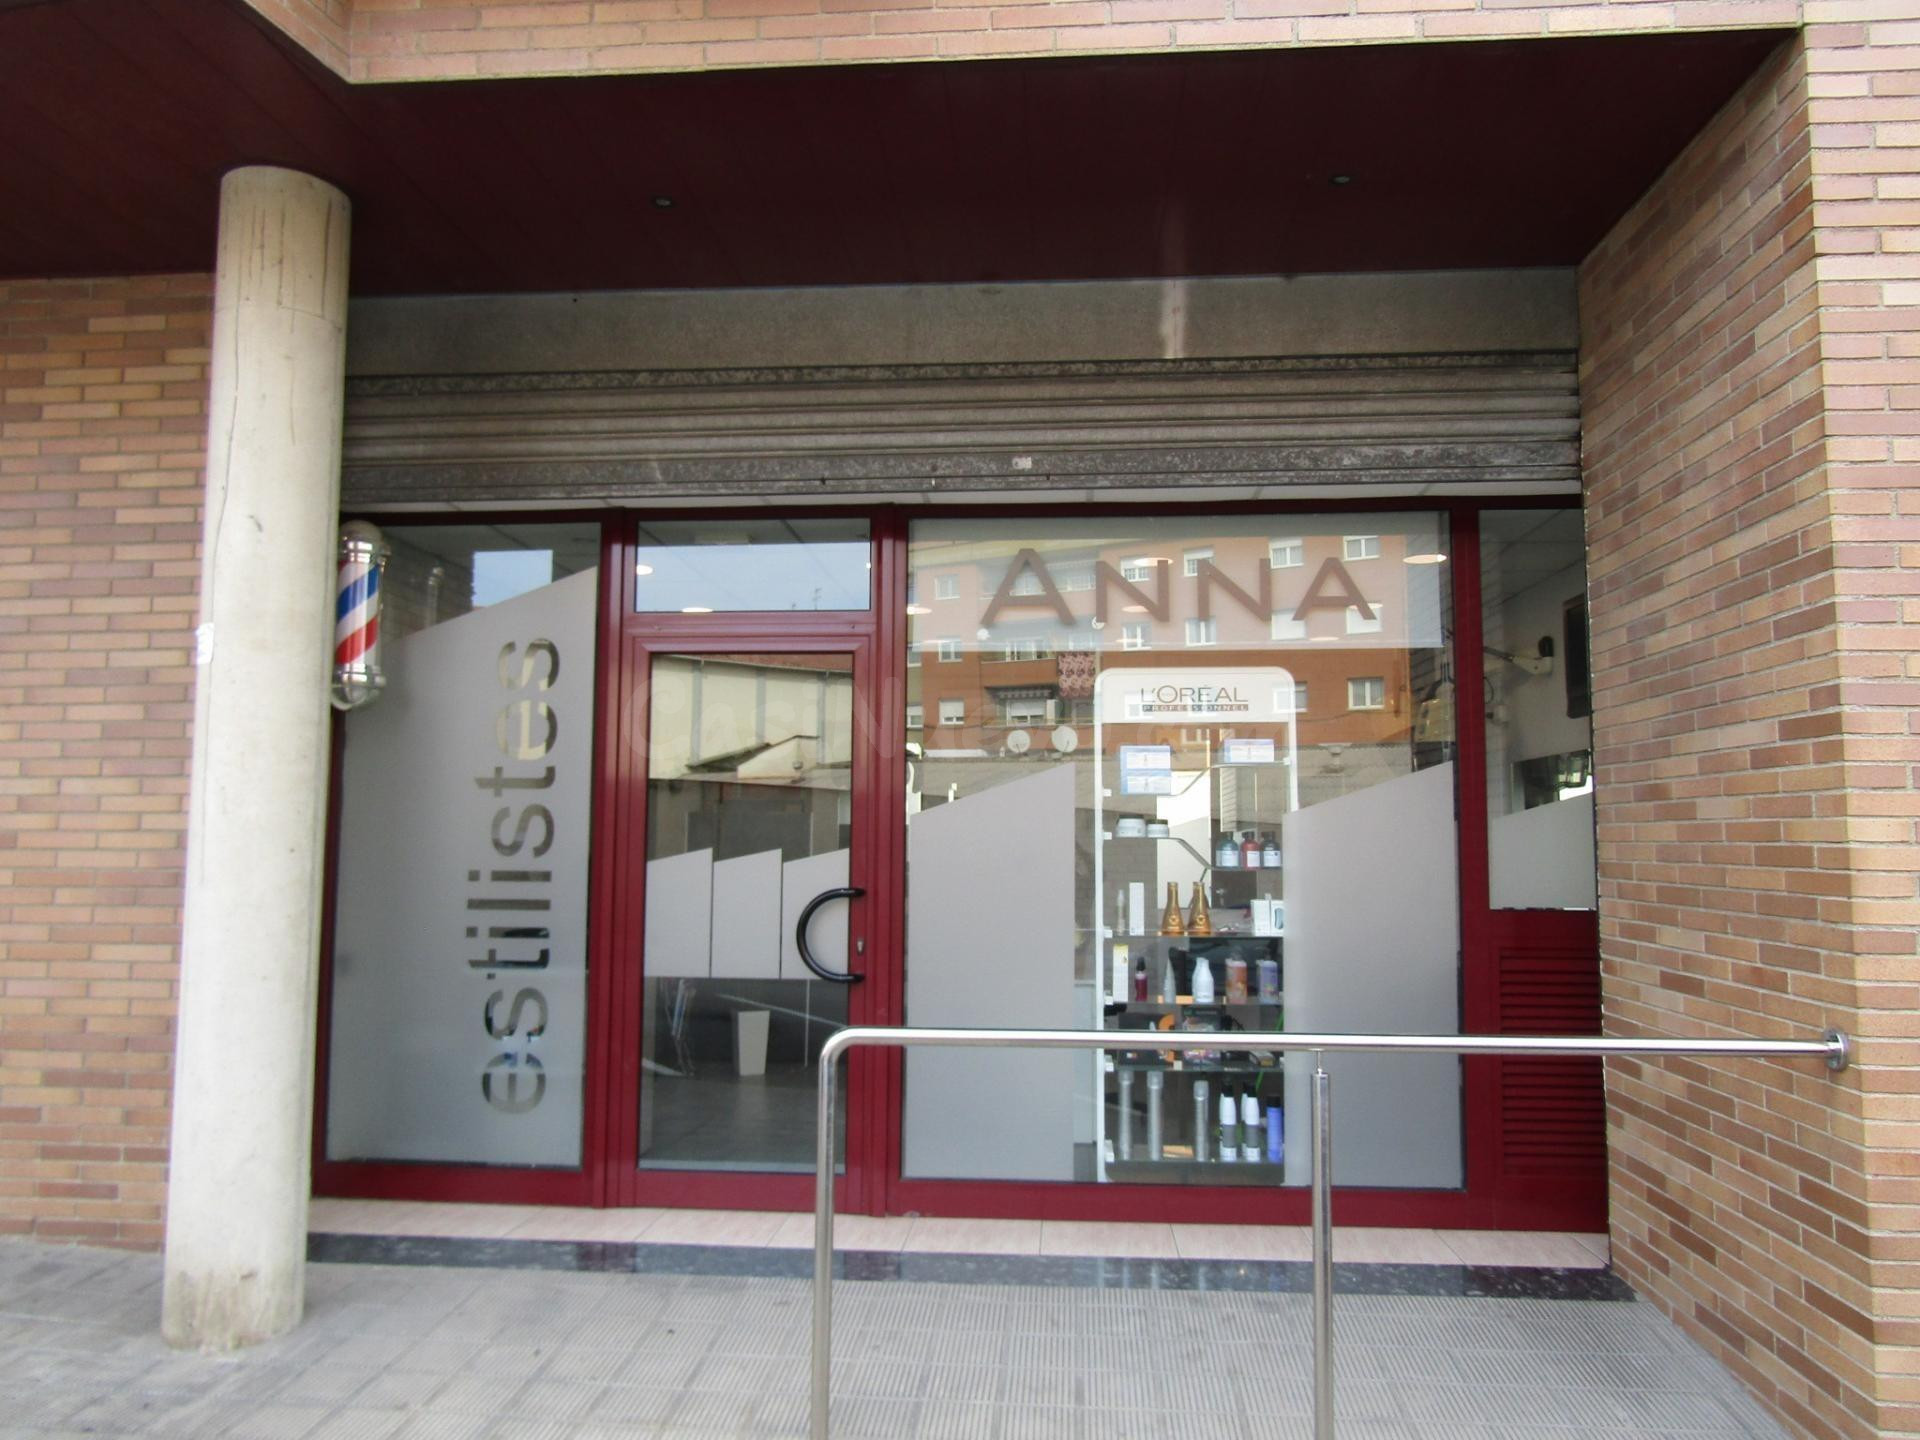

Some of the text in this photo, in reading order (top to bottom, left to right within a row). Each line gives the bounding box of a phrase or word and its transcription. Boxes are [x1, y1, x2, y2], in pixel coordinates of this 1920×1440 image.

[980, 547, 1377, 627] ANNA
[1142, 704, 1249, 713] PROFESONNEL
[465, 637, 560, 1115] estilistes
